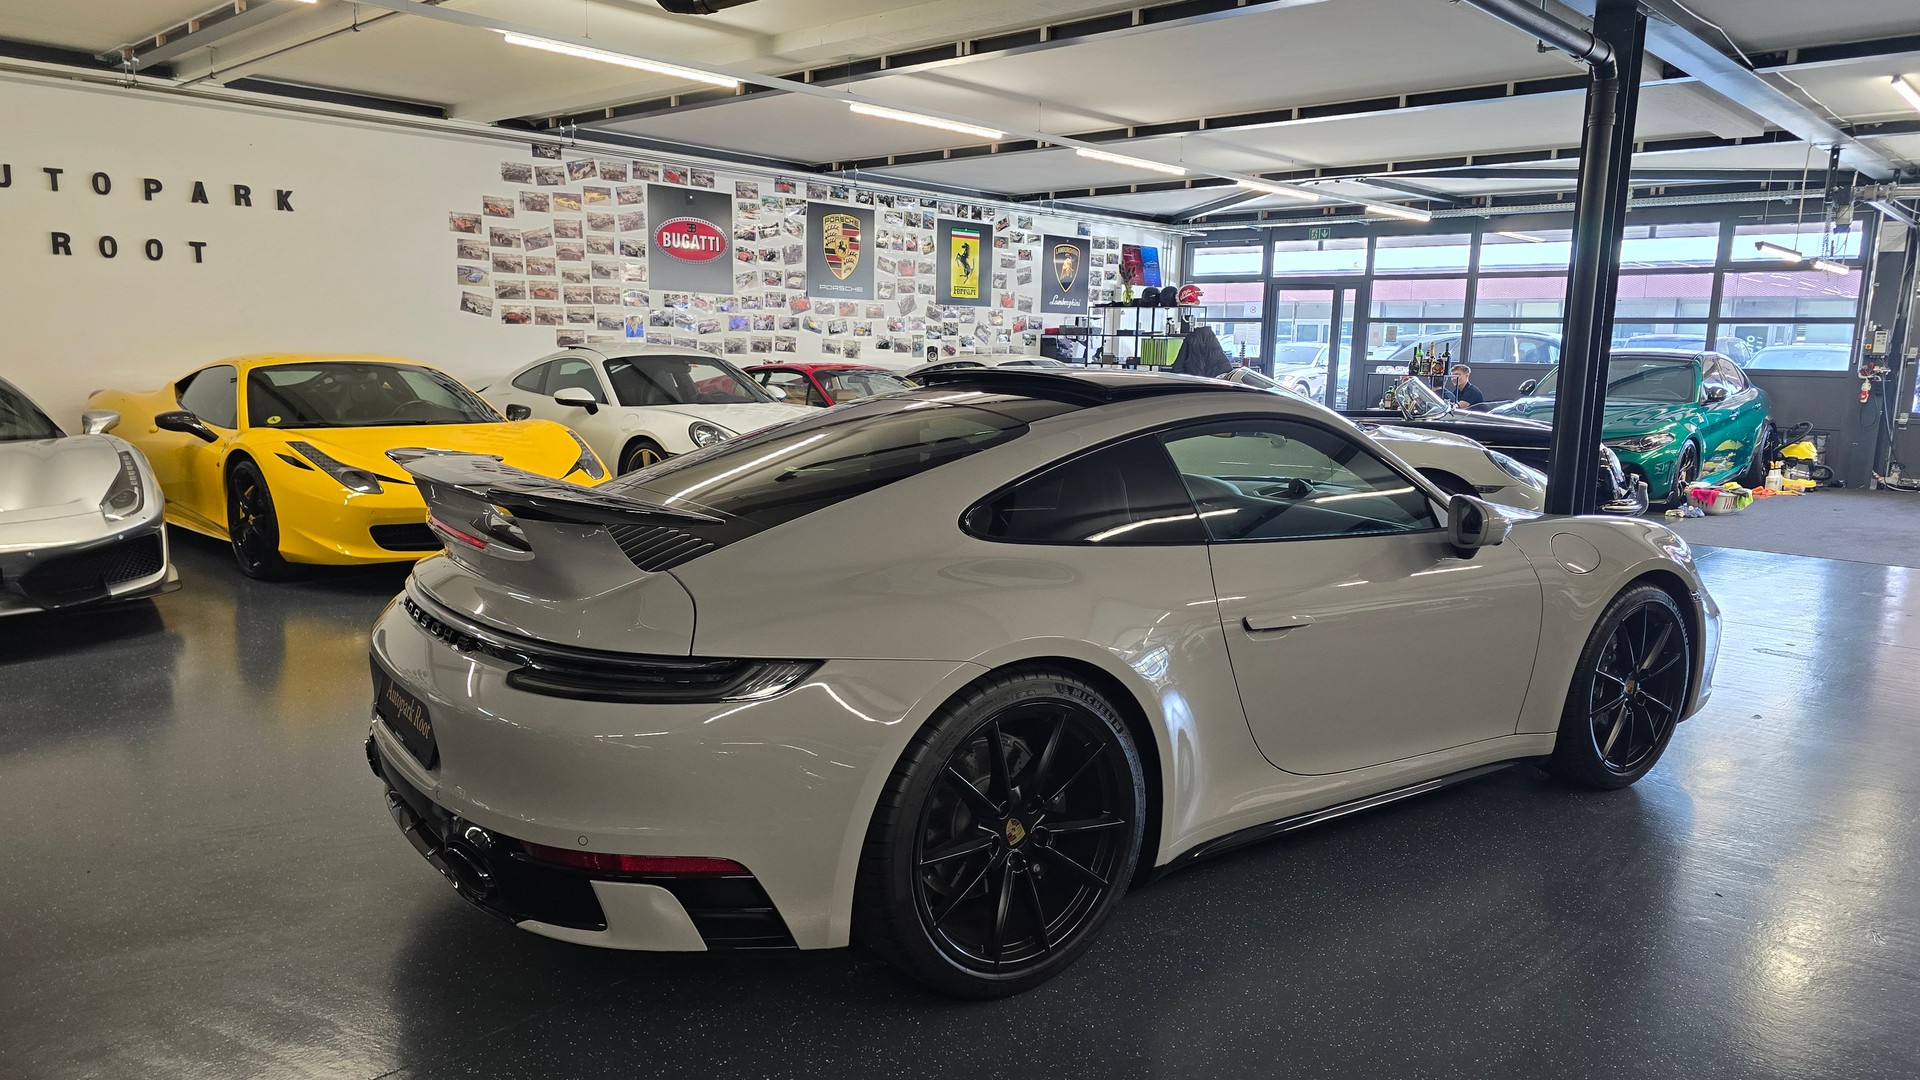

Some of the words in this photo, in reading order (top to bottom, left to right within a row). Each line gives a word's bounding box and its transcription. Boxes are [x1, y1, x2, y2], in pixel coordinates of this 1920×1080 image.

[51, 232, 207, 263] ROOT
[662, 231, 721, 253] BUGATTI
[819, 284, 864, 293] PORSCHE
[953, 286, 977, 296] Ferrari
[1049, 294, 1082, 308] Lamborghini
[386, 680, 415, 722] Autopark
[413, 704, 431, 739] Root
[1071, 687, 1122, 731] MICHELIN
